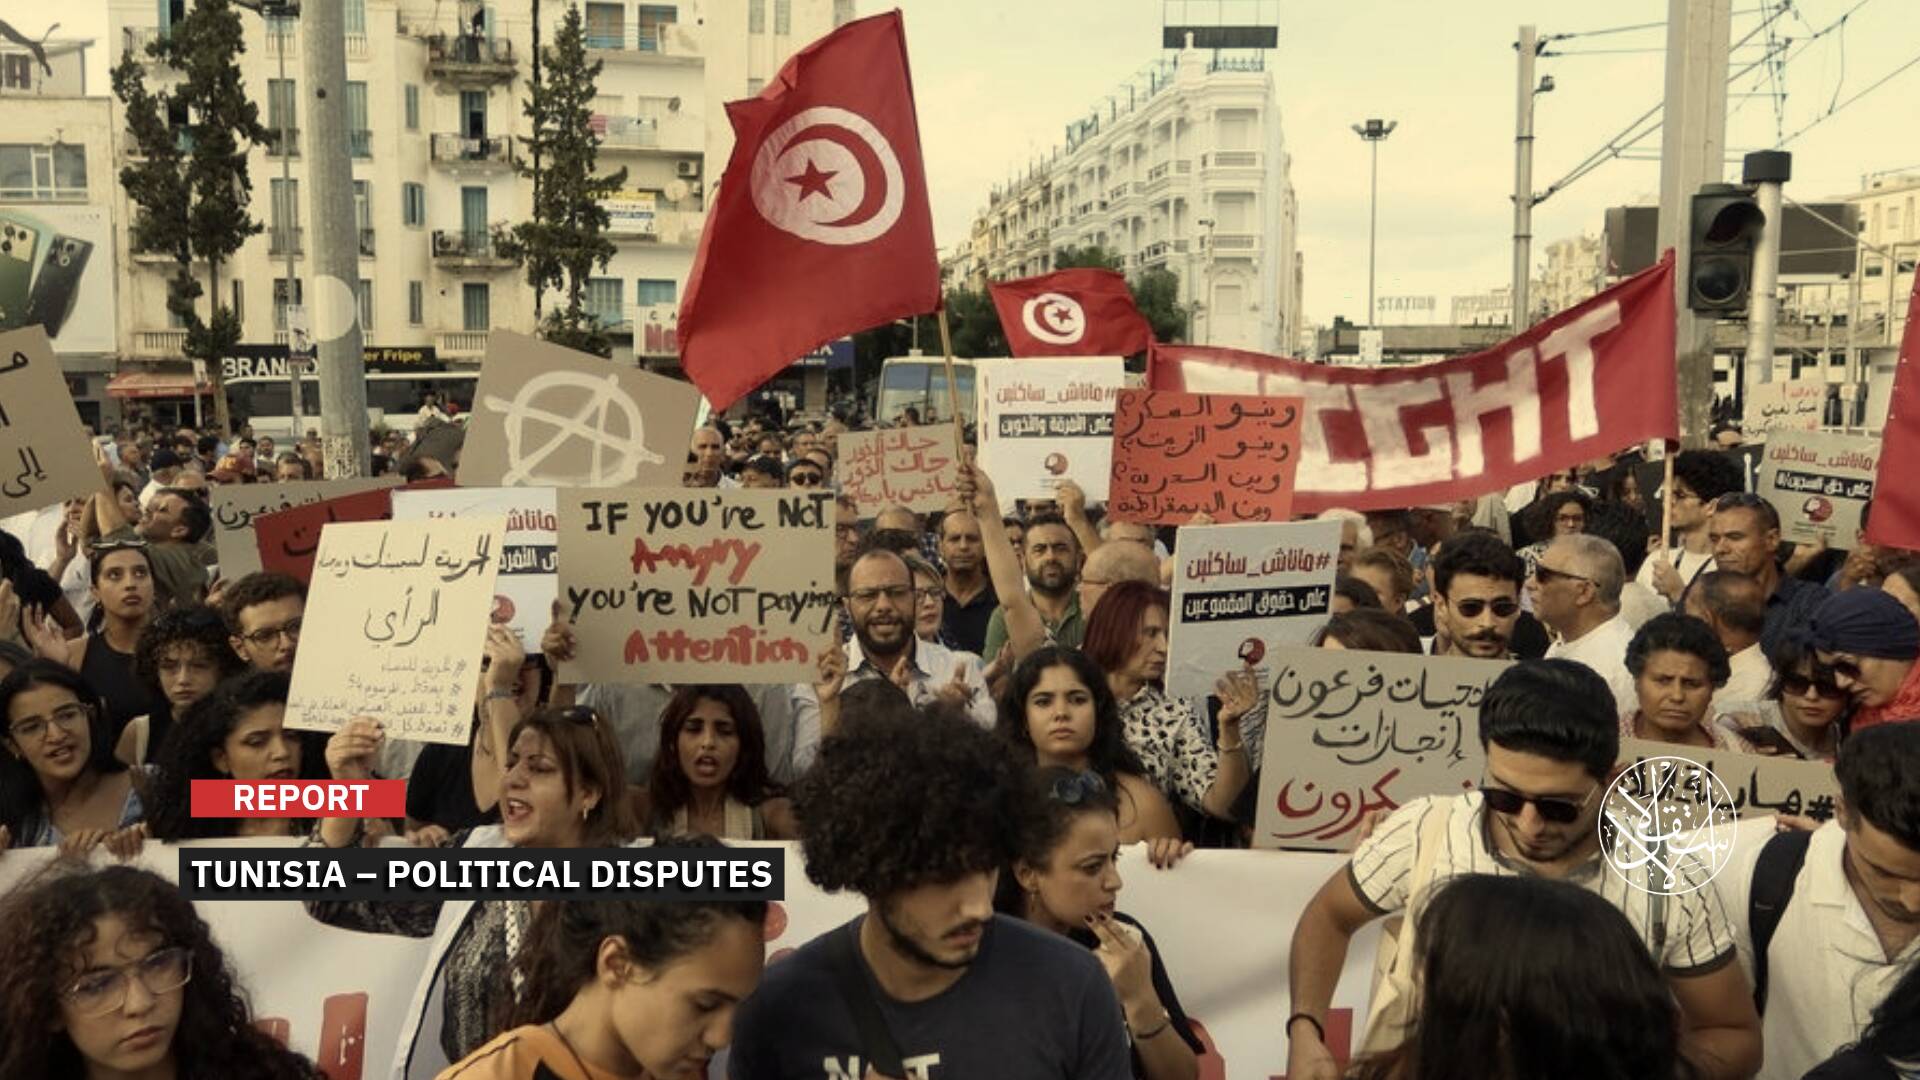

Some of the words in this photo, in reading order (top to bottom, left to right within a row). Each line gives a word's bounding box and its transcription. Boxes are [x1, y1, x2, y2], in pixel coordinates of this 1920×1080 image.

[383, 349, 422, 364] Fripe
[582, 501, 629, 535] IF
[1272, 664, 1385, 719] فرعون
